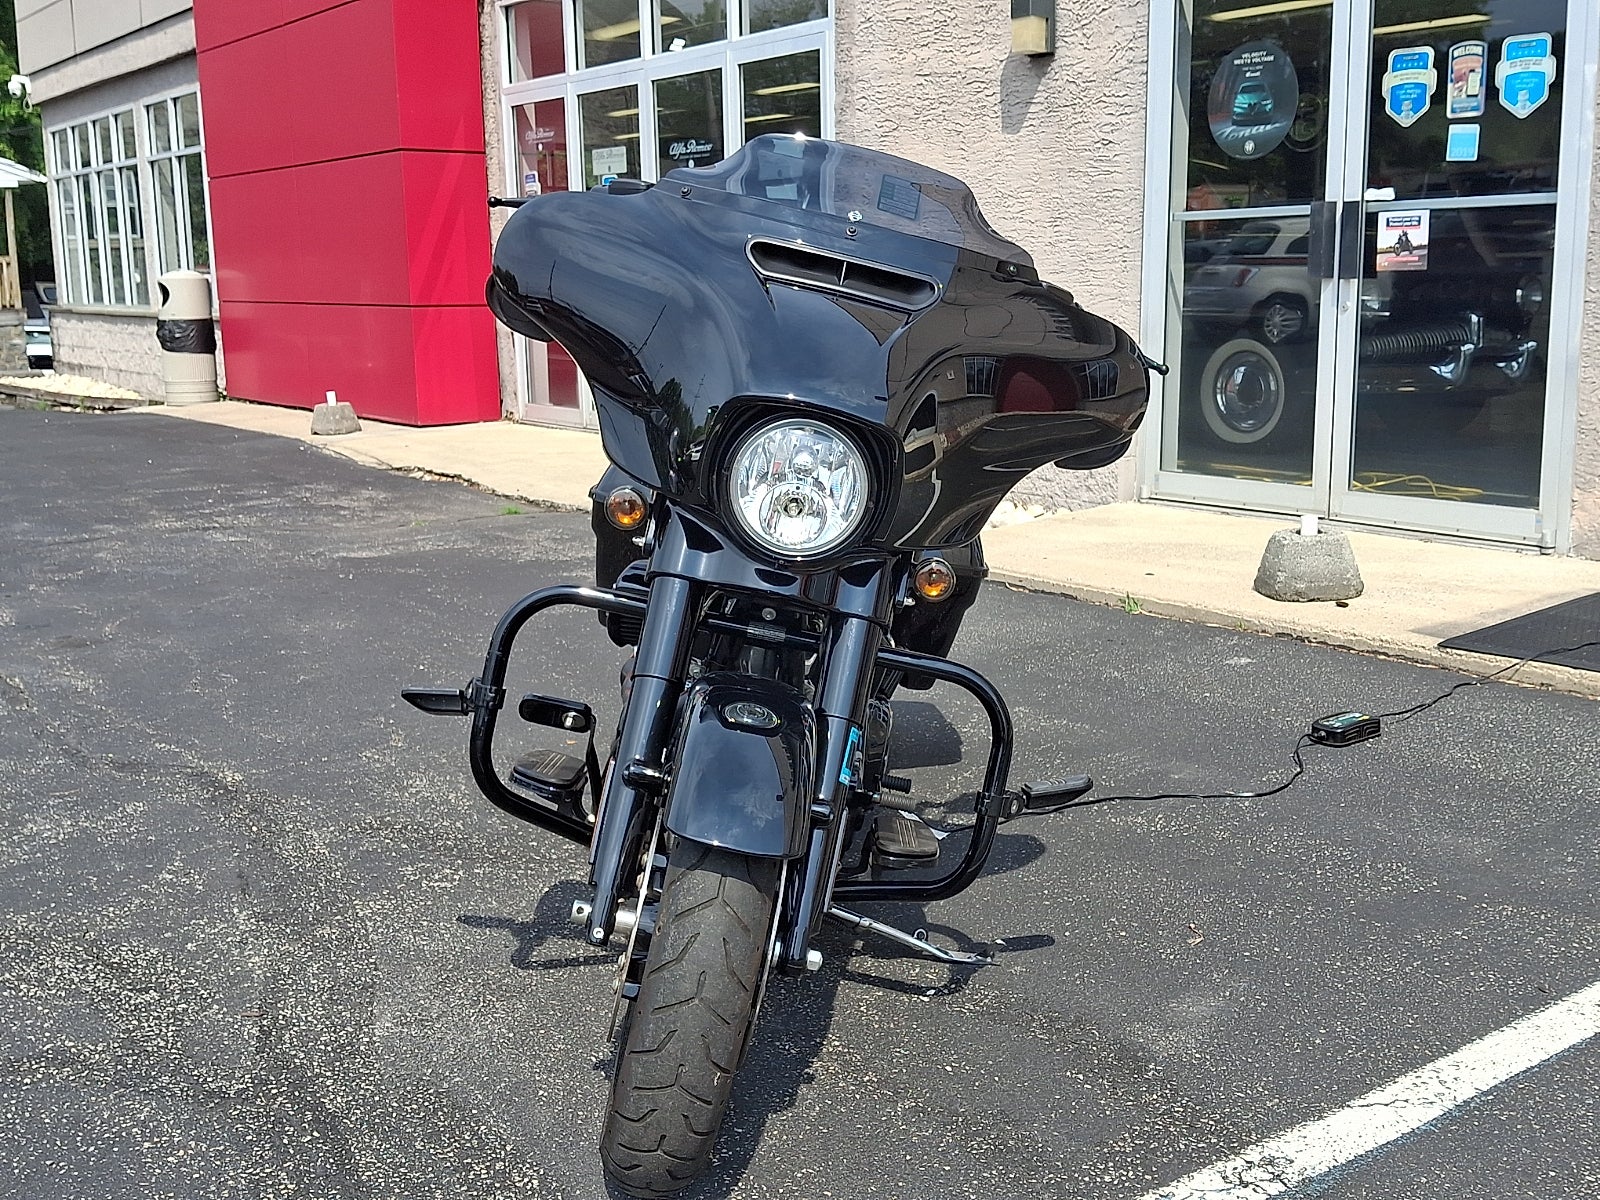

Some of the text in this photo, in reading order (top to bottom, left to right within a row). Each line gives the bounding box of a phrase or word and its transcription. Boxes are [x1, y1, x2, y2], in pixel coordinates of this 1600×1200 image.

[1453, 45, 1483, 58] WELCOME
[670, 139, 713, 160] Alfa Romeo
